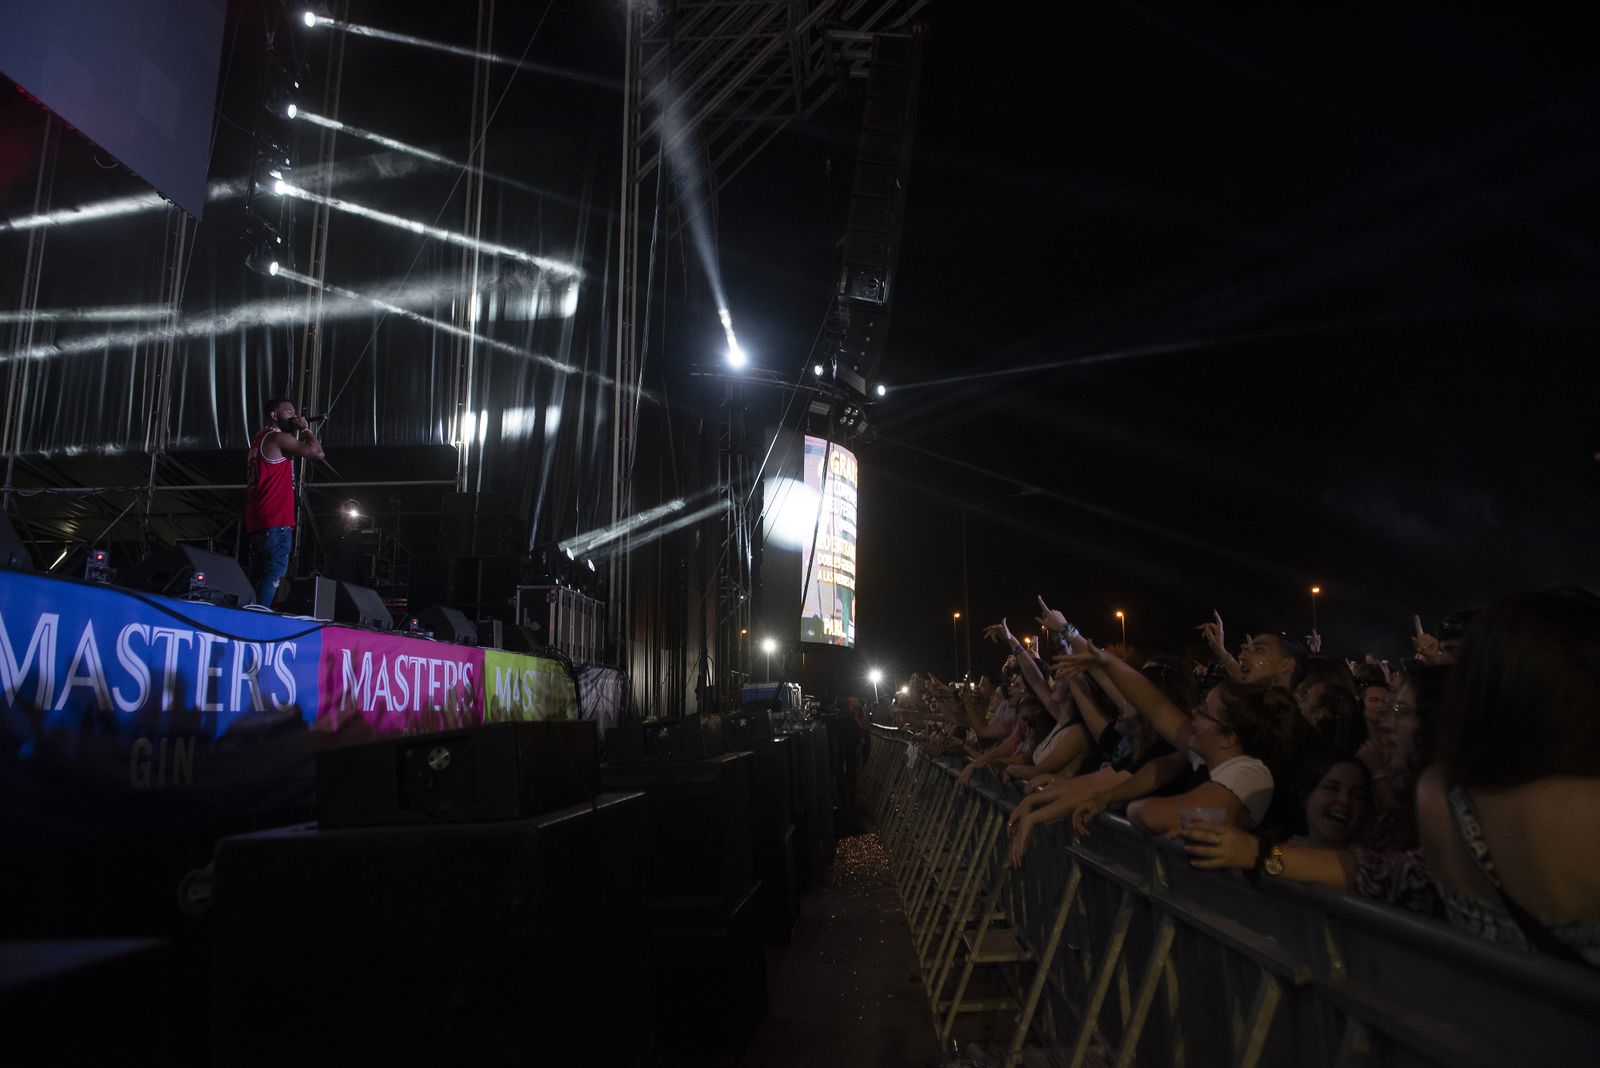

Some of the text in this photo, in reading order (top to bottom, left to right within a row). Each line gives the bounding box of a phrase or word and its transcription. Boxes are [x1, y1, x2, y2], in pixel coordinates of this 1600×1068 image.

[0, 609, 297, 713] MASTER'S
[340, 648, 475, 712] MASTER'S
[129, 736, 196, 790] GIN
